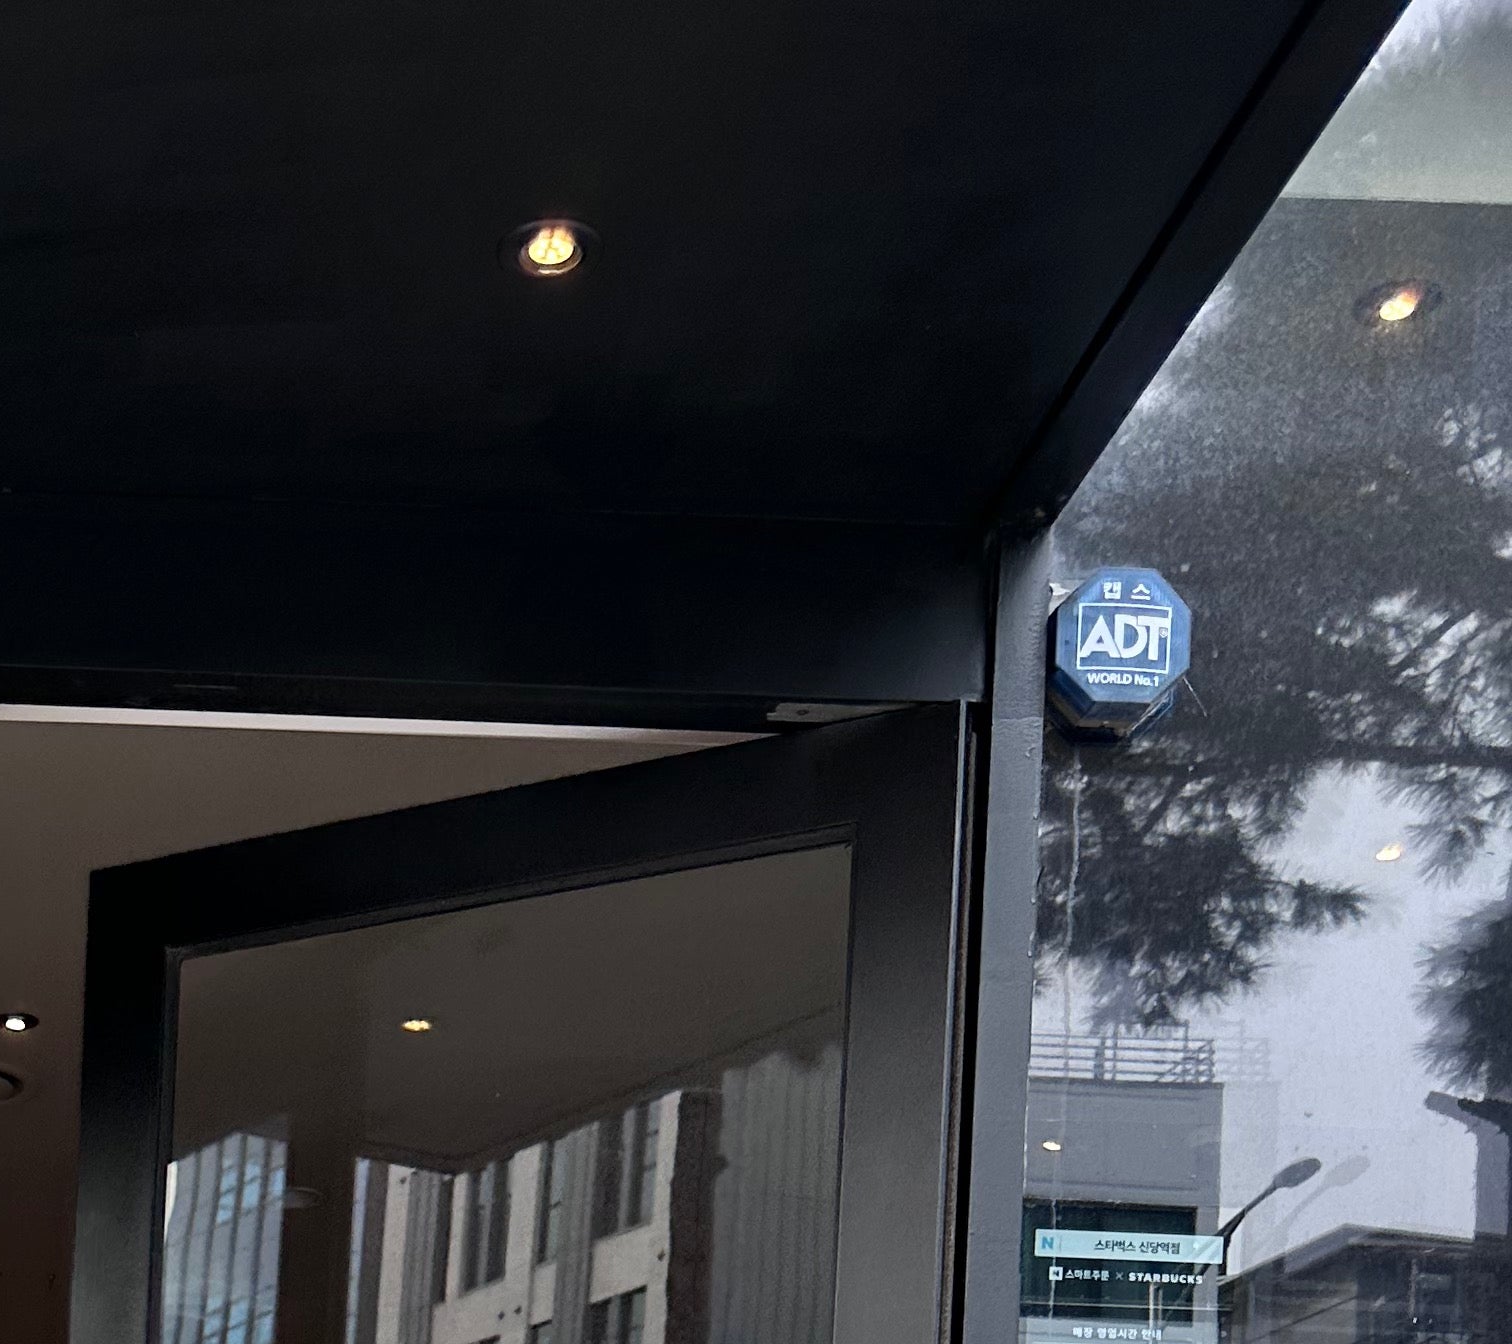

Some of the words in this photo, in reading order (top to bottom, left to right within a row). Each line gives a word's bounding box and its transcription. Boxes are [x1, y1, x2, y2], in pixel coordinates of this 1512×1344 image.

[1079, 614, 1169, 661] ADT
[1088, 673, 1133, 685] WORLD
[1134, 676, 1158, 687] No.1
[1041, 1237, 1054, 1250] N
[1094, 1239, 1136, 1252] 스타벅스
[1139, 1240, 1180, 1255] 신당역점
[1065, 1269, 1110, 1281] 스마트주문
[1128, 1271, 1203, 1285] STARBUCKS
[1072, 1326, 1094, 1337] 매장
[1097, 1327, 1137, 1339] 영업시간
[1141, 1328, 1162, 1341] 안내
